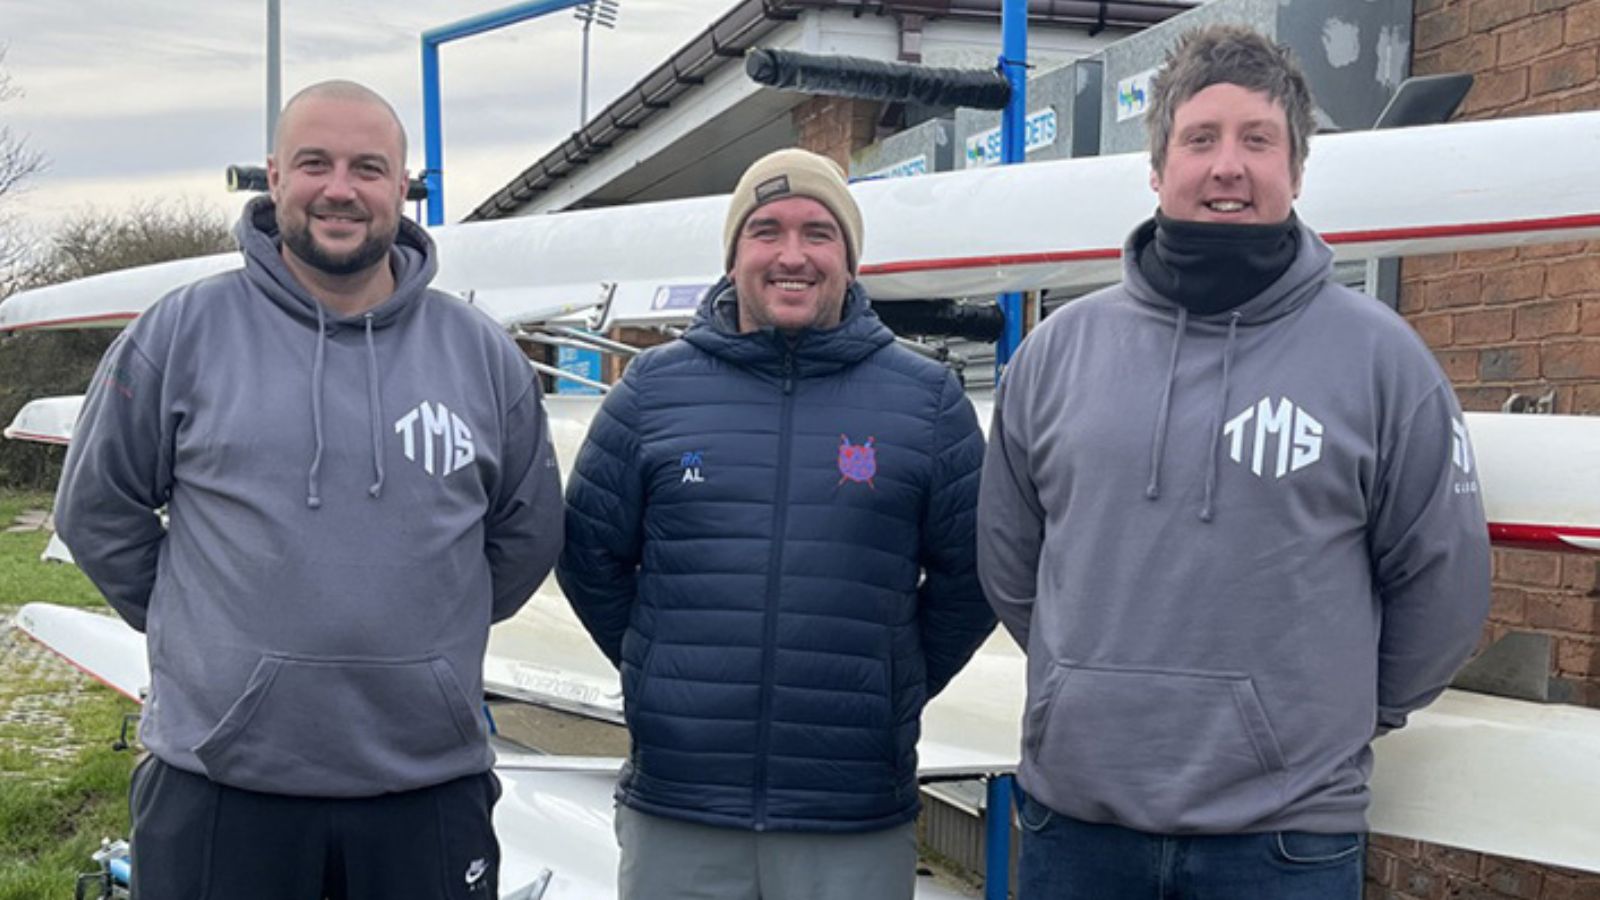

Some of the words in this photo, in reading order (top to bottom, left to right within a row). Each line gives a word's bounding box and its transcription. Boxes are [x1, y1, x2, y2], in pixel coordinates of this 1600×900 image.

[394, 399, 476, 477] TMS
[682, 467, 704, 482] AL
[1223, 395, 1325, 479] TMS
